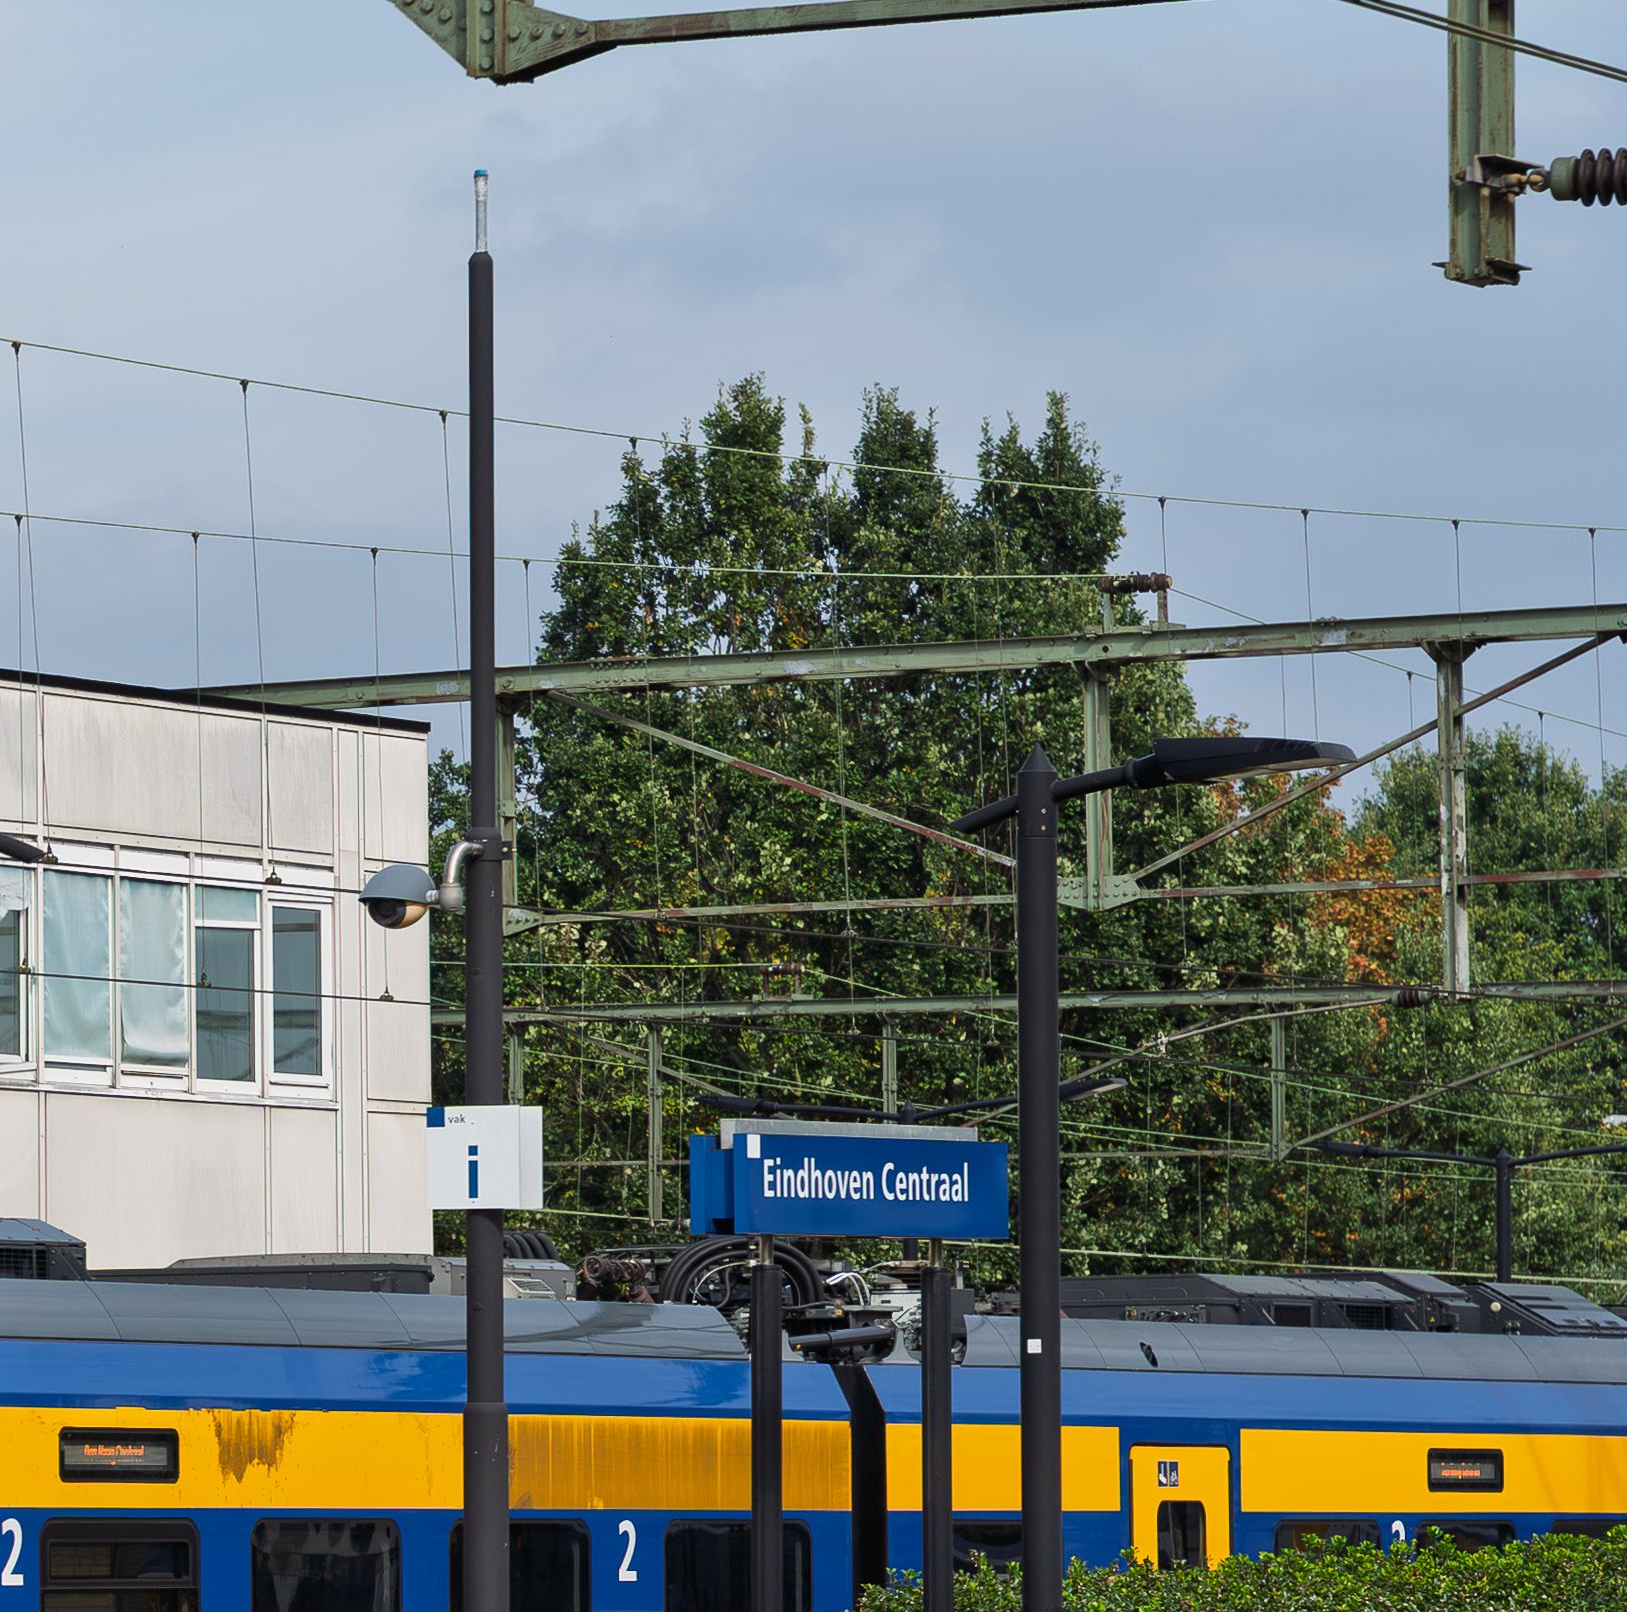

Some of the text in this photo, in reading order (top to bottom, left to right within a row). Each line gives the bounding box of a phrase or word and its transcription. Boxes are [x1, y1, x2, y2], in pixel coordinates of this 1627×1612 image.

[448, 1113, 466, 1124] vak
[763, 1157, 969, 1202] Eindhoven Centraal
[1, 1518, 24, 1586] 2
[618, 1520, 638, 1581] 2
